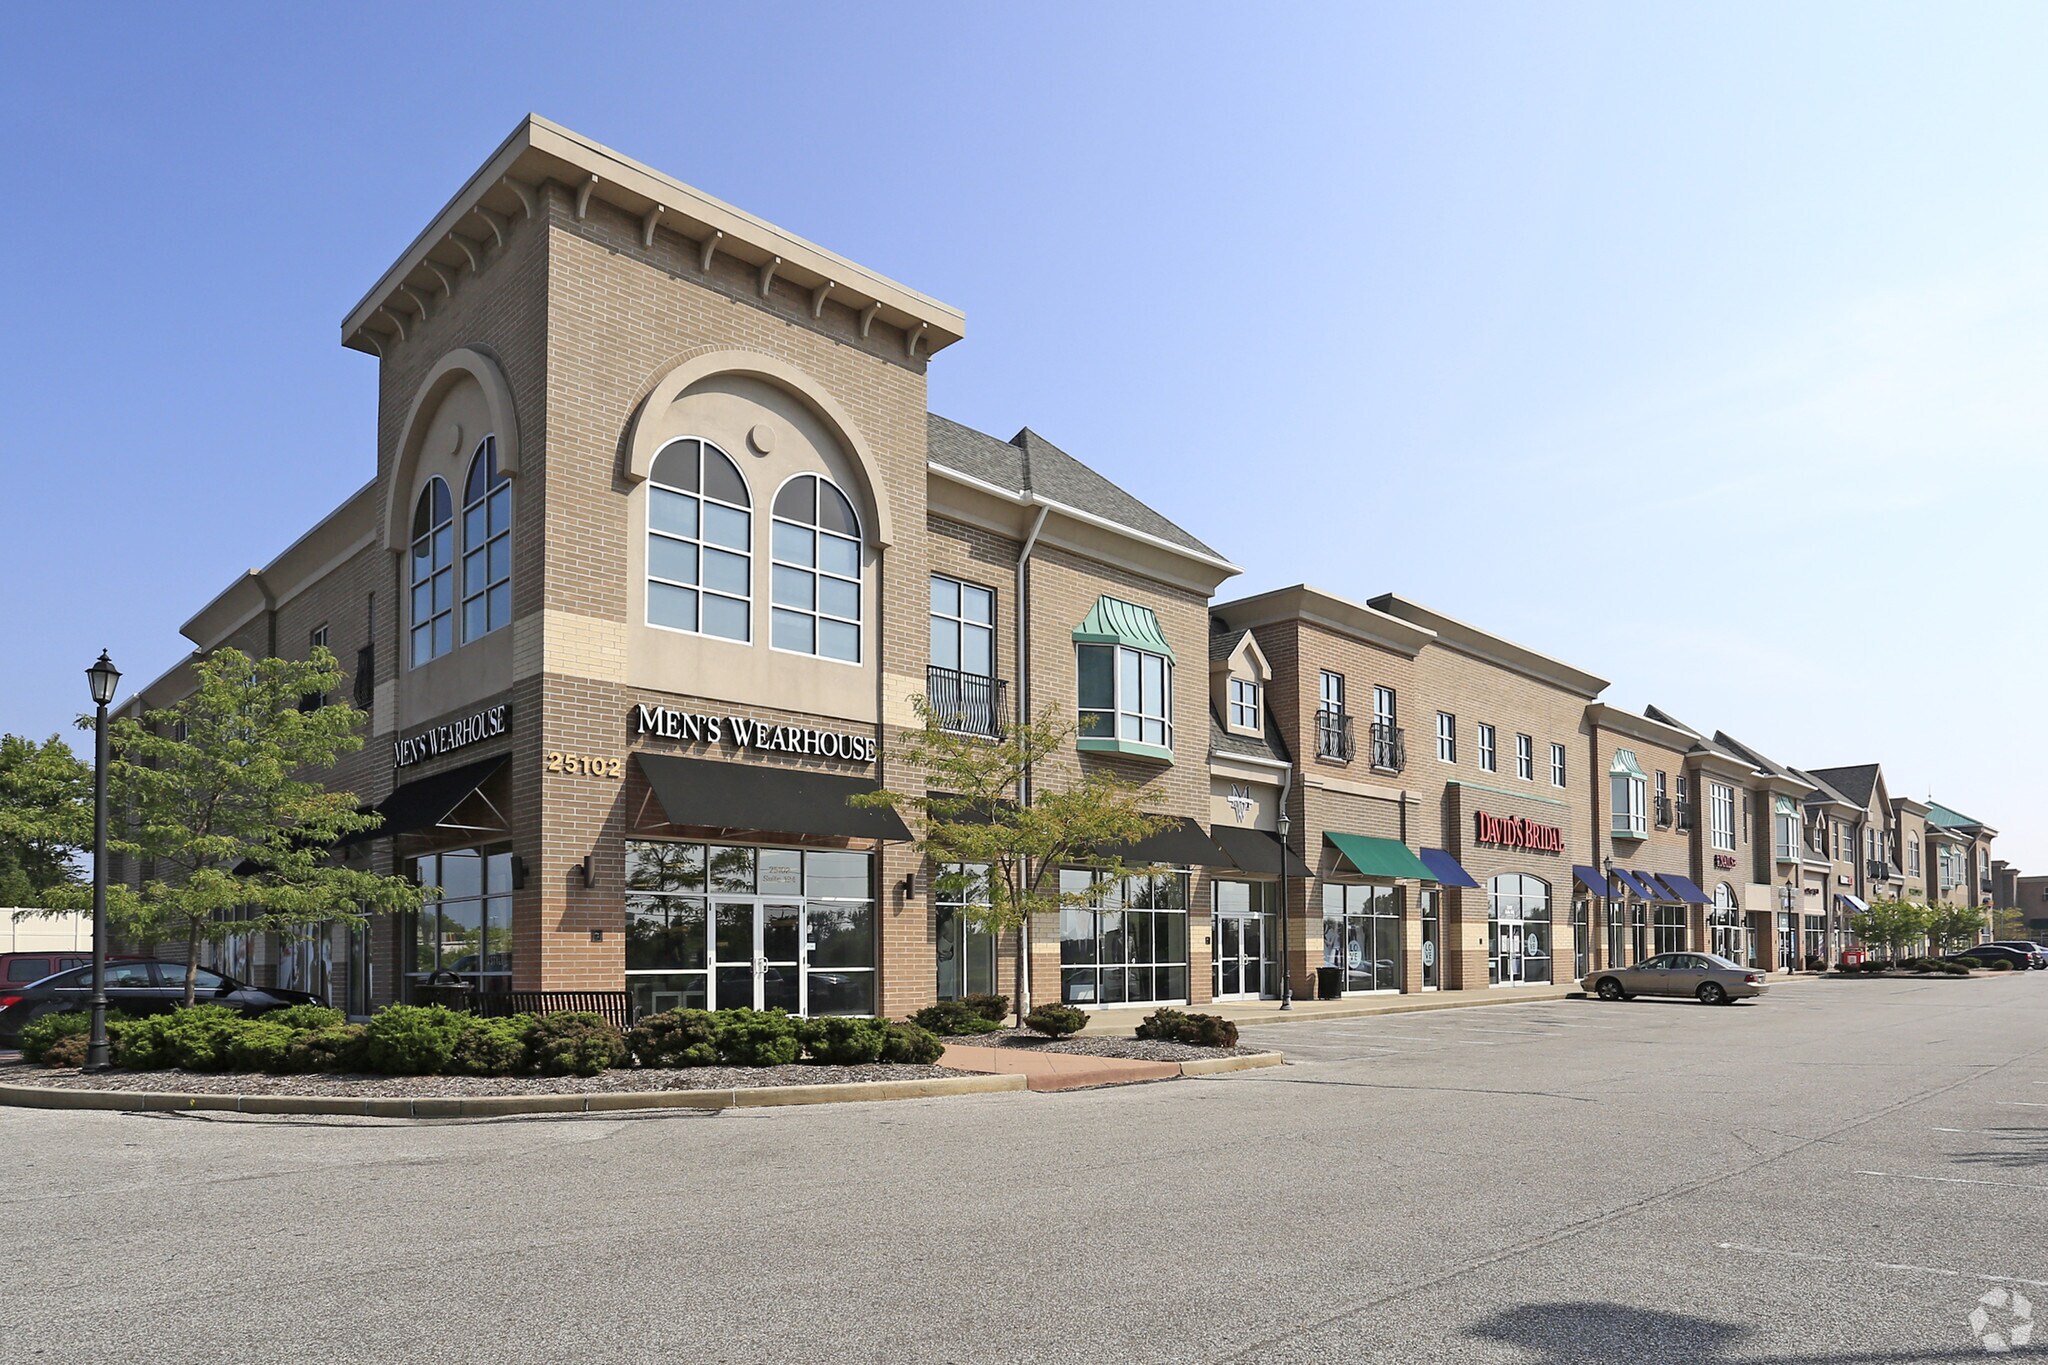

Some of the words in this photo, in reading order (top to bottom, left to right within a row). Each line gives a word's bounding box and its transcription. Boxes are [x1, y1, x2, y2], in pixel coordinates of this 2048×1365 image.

[393, 734, 427, 769] MEN'S
[428, 704, 505, 755] WEARHOUSE
[636, 703, 722, 743] MEN'S
[727, 715, 877, 763] WEARHOUSE
[547, 751, 622, 778] 25102
[1478, 811, 1523, 848] DAVID'S
[1523, 819, 1565, 852] BRIDAL
